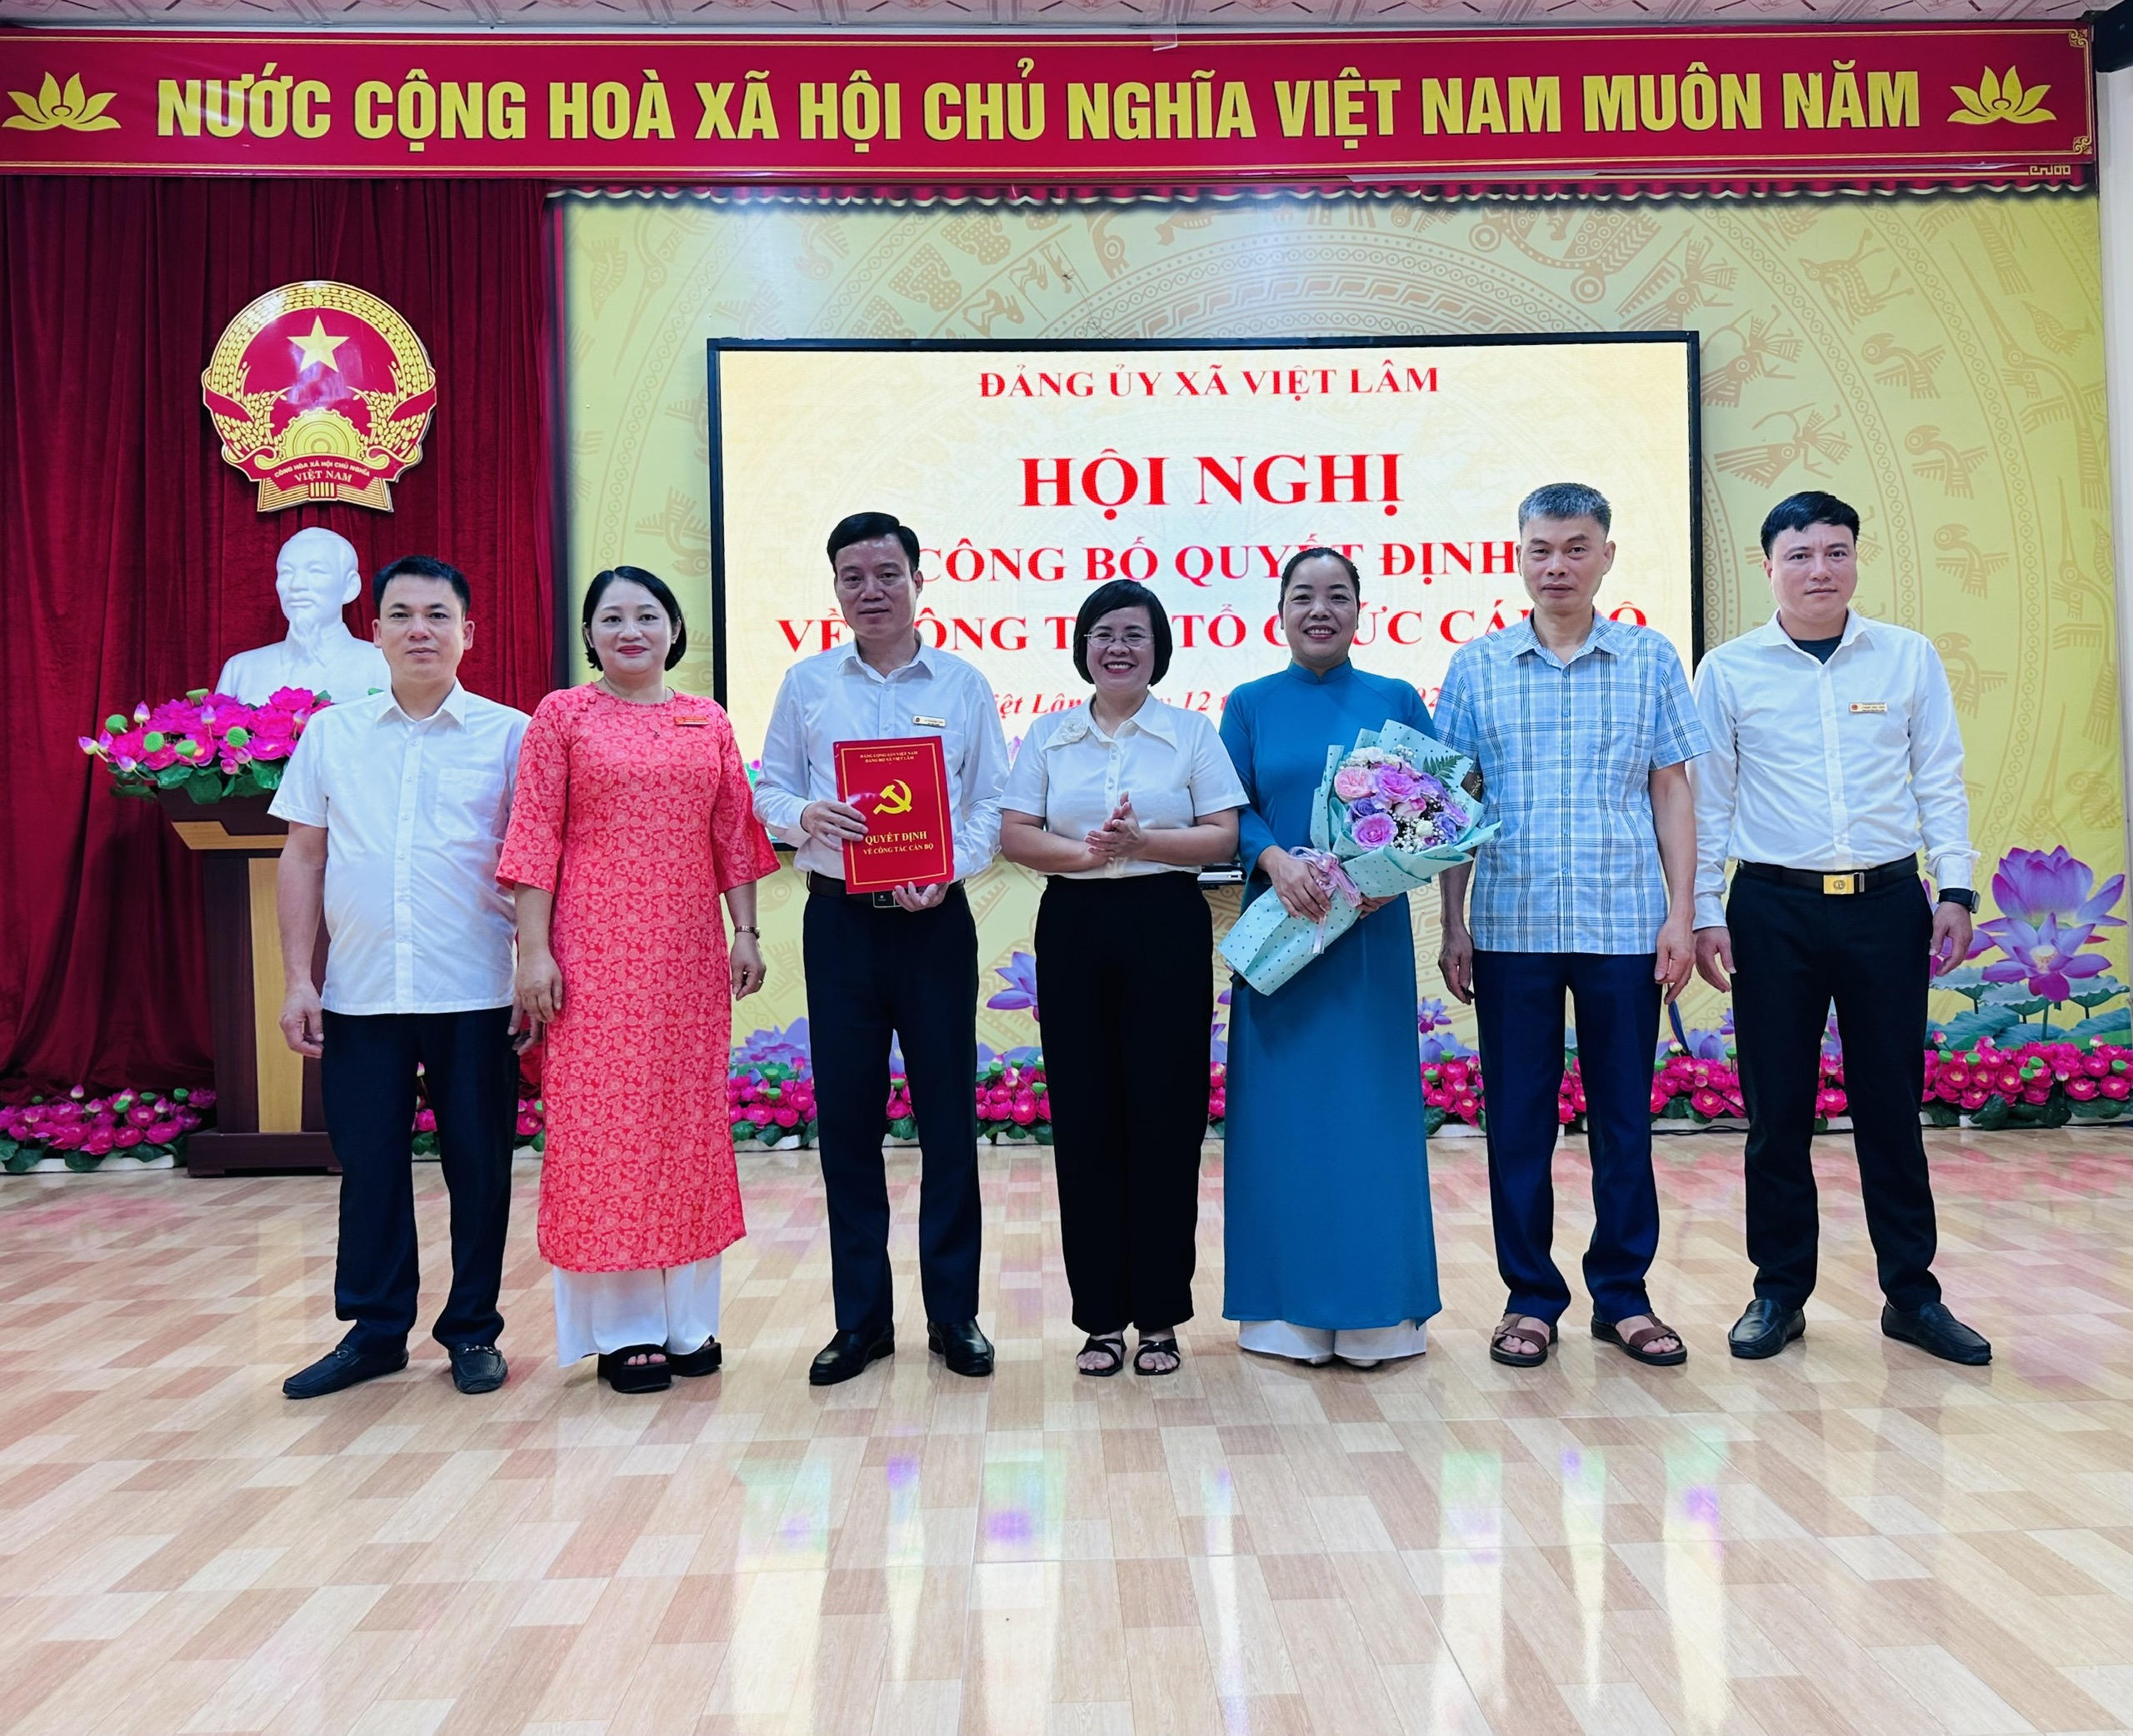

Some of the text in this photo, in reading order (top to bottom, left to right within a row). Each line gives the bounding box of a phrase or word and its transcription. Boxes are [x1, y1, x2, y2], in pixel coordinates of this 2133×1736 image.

[158, 57, 1921, 153] NƯỚC CỘNG HOÀ XÃ HỘI CHỦ NGHĨA VIỆT NAM MUÔN NĂM
[978, 359, 1440, 402] ĐẢNG ỦY XÃ VIỆT LÂM
[294, 469, 352, 482] VIỆT NAM
[1018, 447, 1403, 521] HỘI NGHỊ
[1083, 536, 1159, 581] BỐ
[1379, 541, 1518, 585] ĐỊNH
[914, 606, 1029, 651] ÔNG
[1171, 603, 1246, 648] TỔ
[1184, 691, 1211, 711] 12
[865, 831, 927, 846] QUYẾT ĐỊNH
[873, 846, 893, 855] CÔNG
[894, 844, 908, 853] TÁC
[908, 843, 923, 852] CÁN
[924, 841, 934, 851] BỘ
